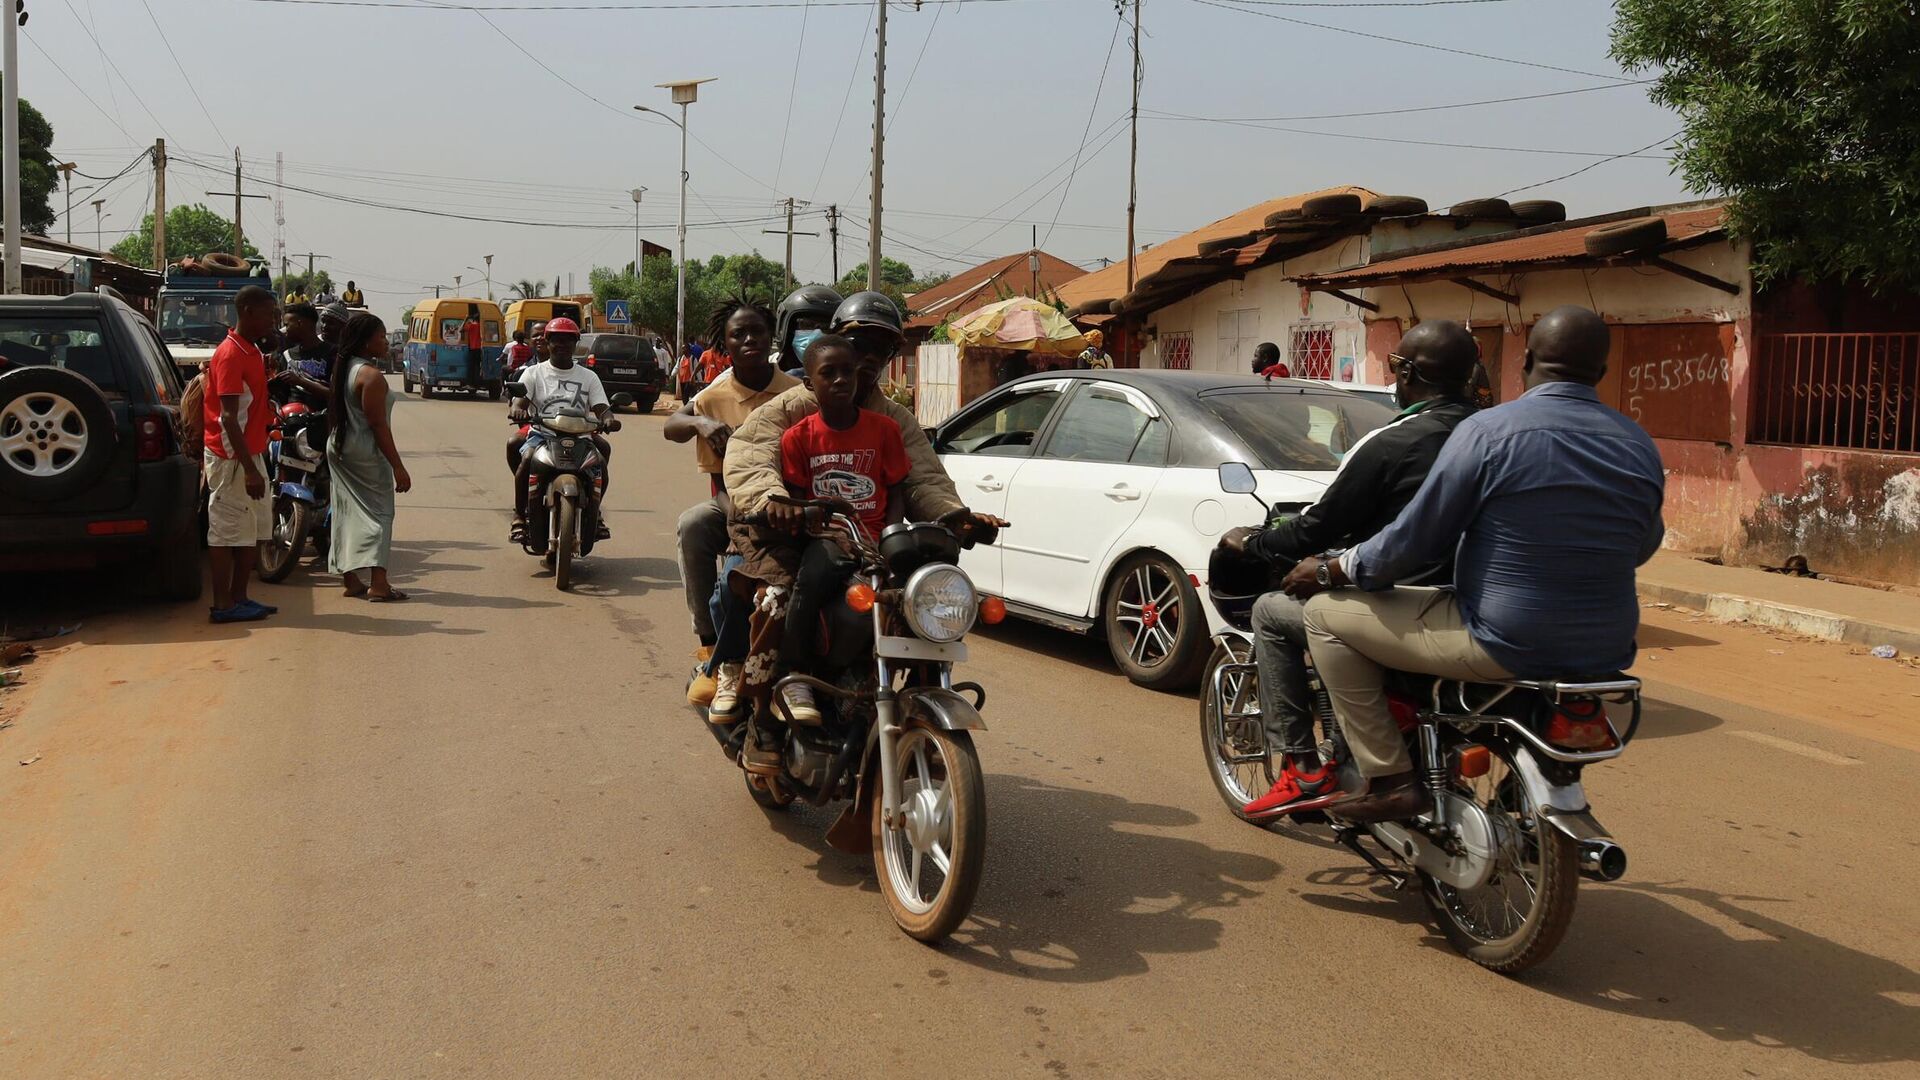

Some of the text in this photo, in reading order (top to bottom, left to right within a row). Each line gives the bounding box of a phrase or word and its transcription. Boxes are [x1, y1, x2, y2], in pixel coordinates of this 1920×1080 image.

[1628, 353, 1729, 392] 95535648
[1629, 396, 1643, 422] 5
[810, 454, 840, 467] INCREASE
[841, 453, 854, 465] THE
[854, 449, 876, 473] 77
[850, 501, 876, 509] ACING
